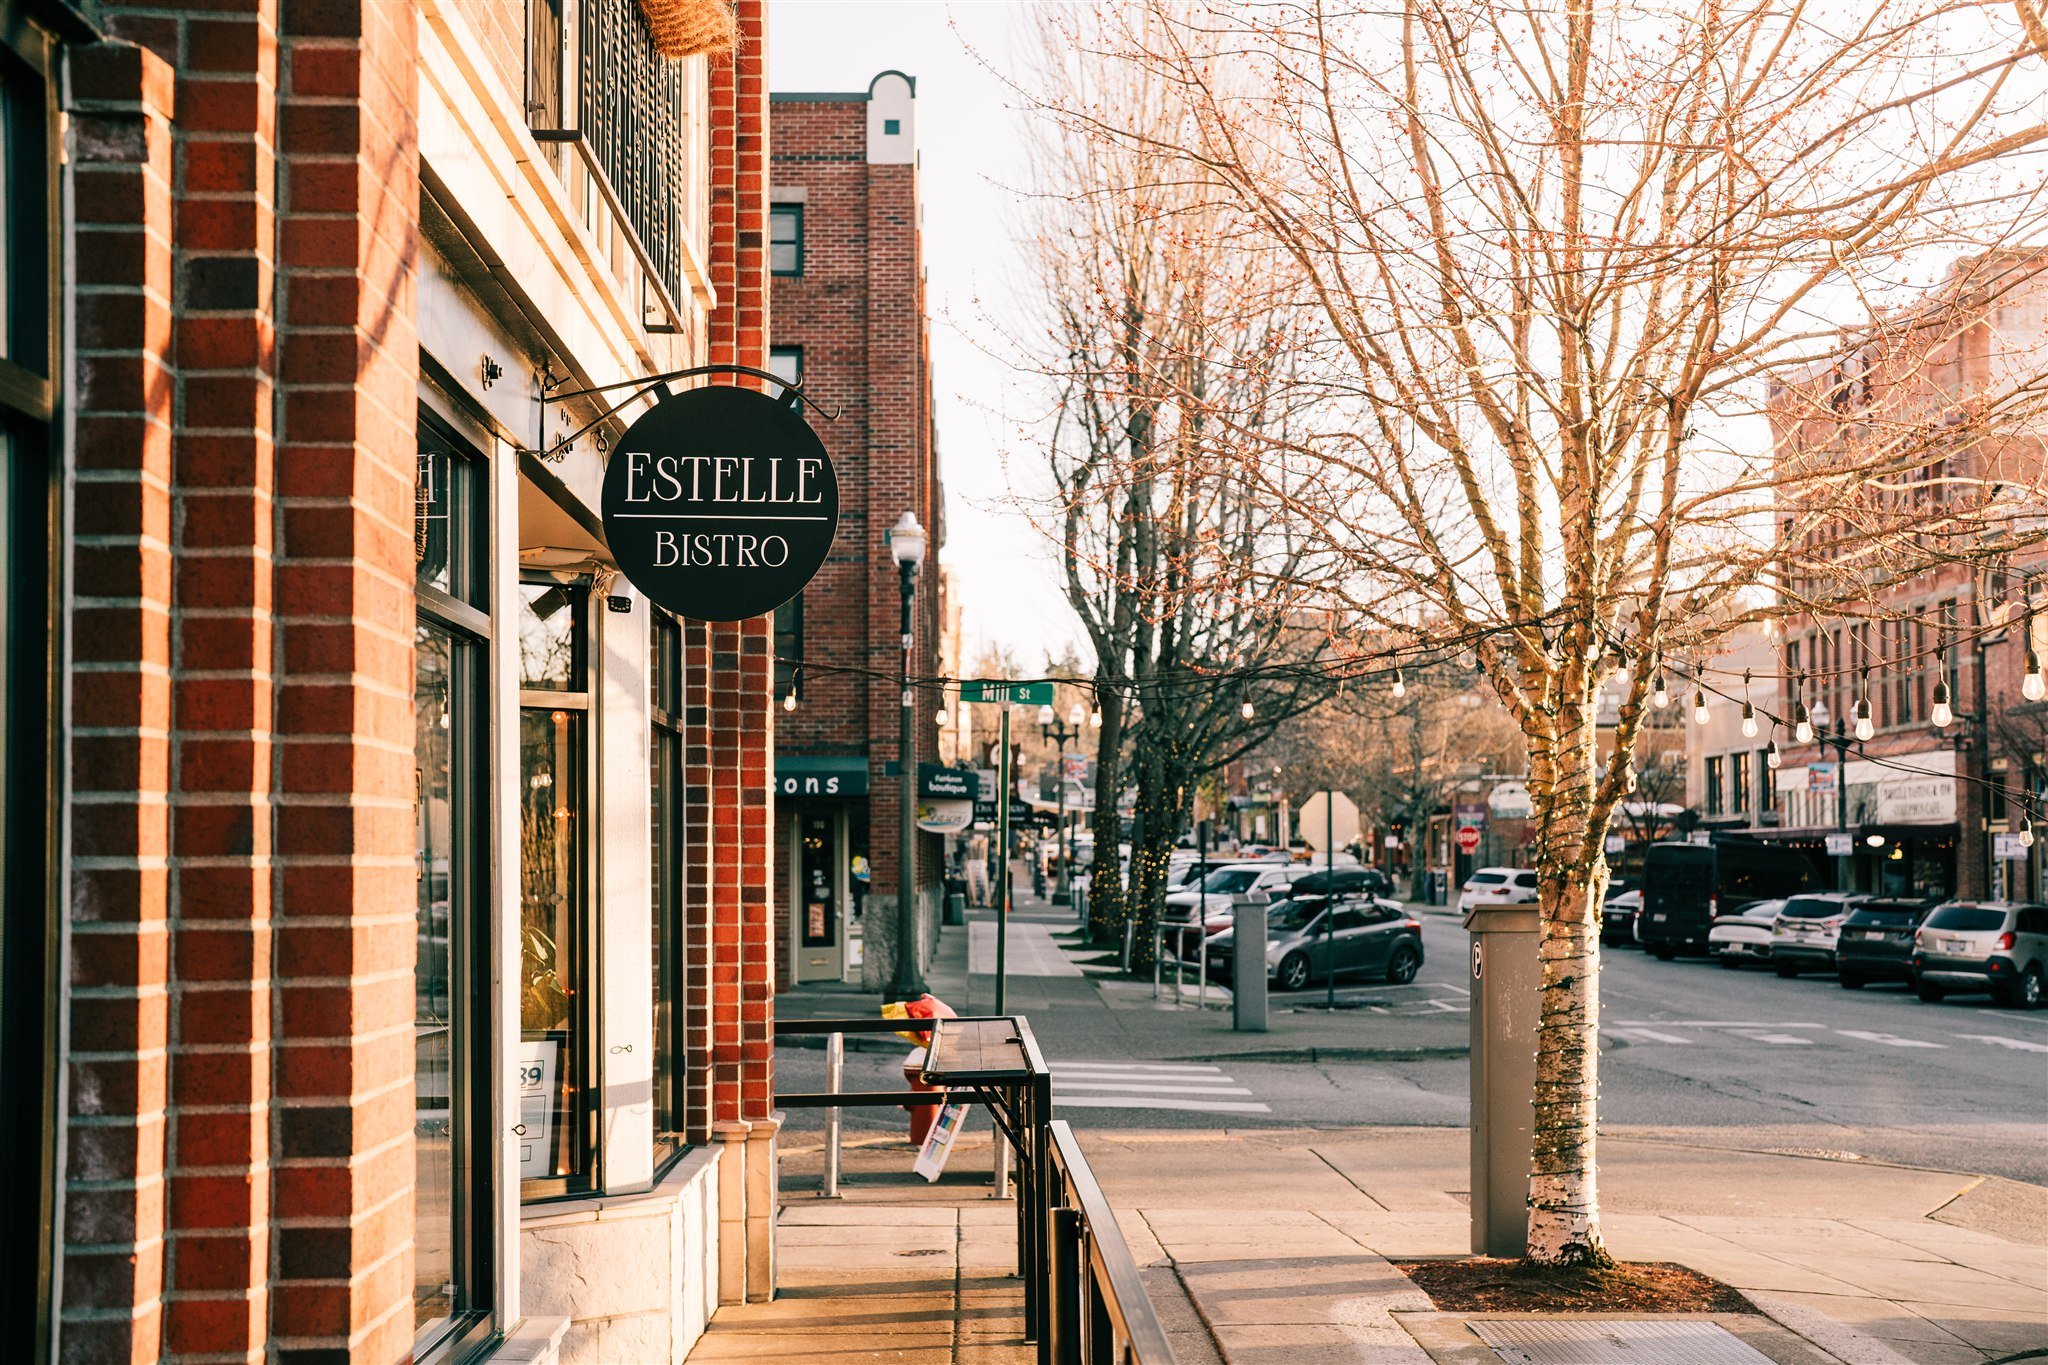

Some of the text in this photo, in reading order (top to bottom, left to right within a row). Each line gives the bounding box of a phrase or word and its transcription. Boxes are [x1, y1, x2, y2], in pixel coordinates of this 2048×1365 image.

[625, 452, 823, 504] ESTELLE
[653, 531, 789, 567] BISTRO
[981, 683, 1031, 702] Mill St
[928, 780, 968, 795] boutique
[1458, 832, 1478, 842] STOP
